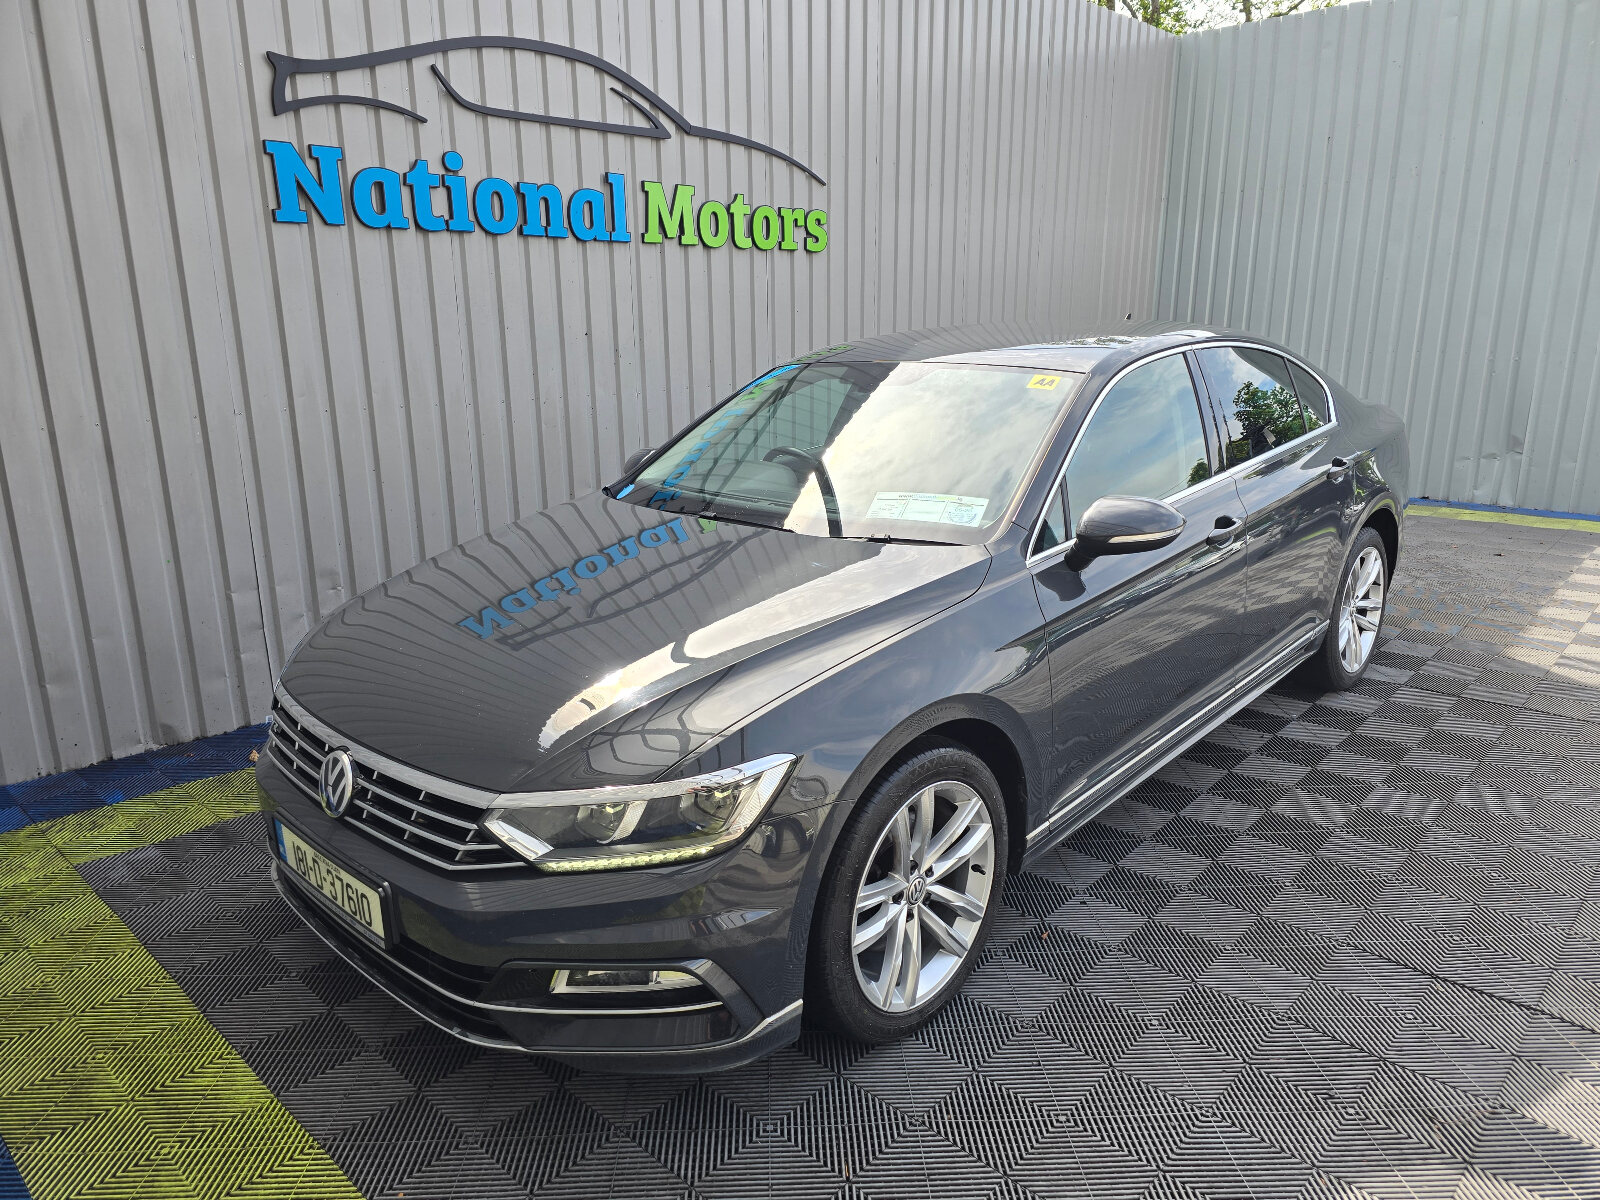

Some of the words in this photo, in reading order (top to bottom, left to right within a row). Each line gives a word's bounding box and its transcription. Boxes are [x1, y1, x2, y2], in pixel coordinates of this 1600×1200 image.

[263, 140, 631, 242] National
[641, 180, 828, 253] Motors
[1033, 377, 1056, 387] AA
[292, 841, 372, 928] 181-D-37610
